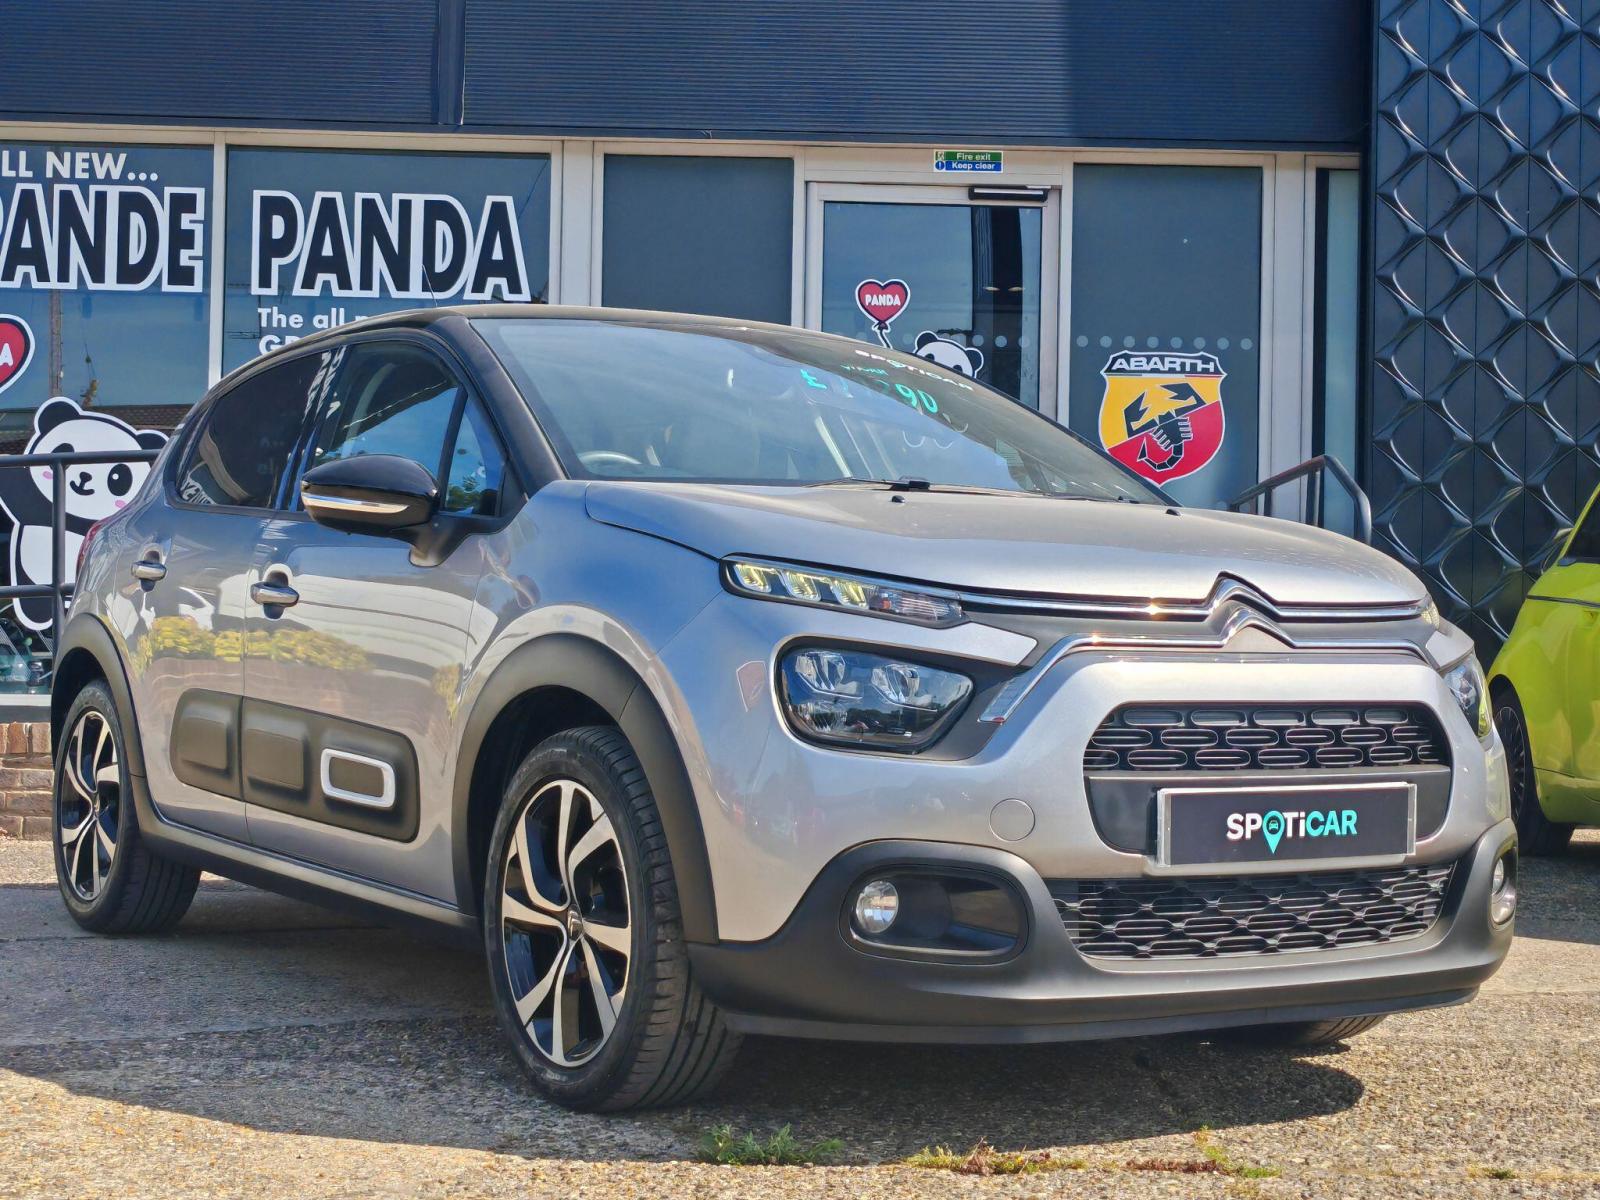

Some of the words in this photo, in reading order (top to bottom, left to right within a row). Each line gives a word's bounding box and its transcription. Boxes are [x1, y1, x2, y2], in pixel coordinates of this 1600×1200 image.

[0, 150, 33, 178] LL
[956, 152, 974, 160] Fire
[975, 153, 991, 161] exit
[952, 161, 973, 170] Keep
[975, 161, 995, 170] clear
[0, 182, 205, 293] ANDE
[251, 189, 531, 302] PANDA
[865, 294, 901, 306] PANDA
[257, 306, 304, 329] The
[312, 307, 346, 329] all
[1112, 356, 1215, 373] ABARTH
